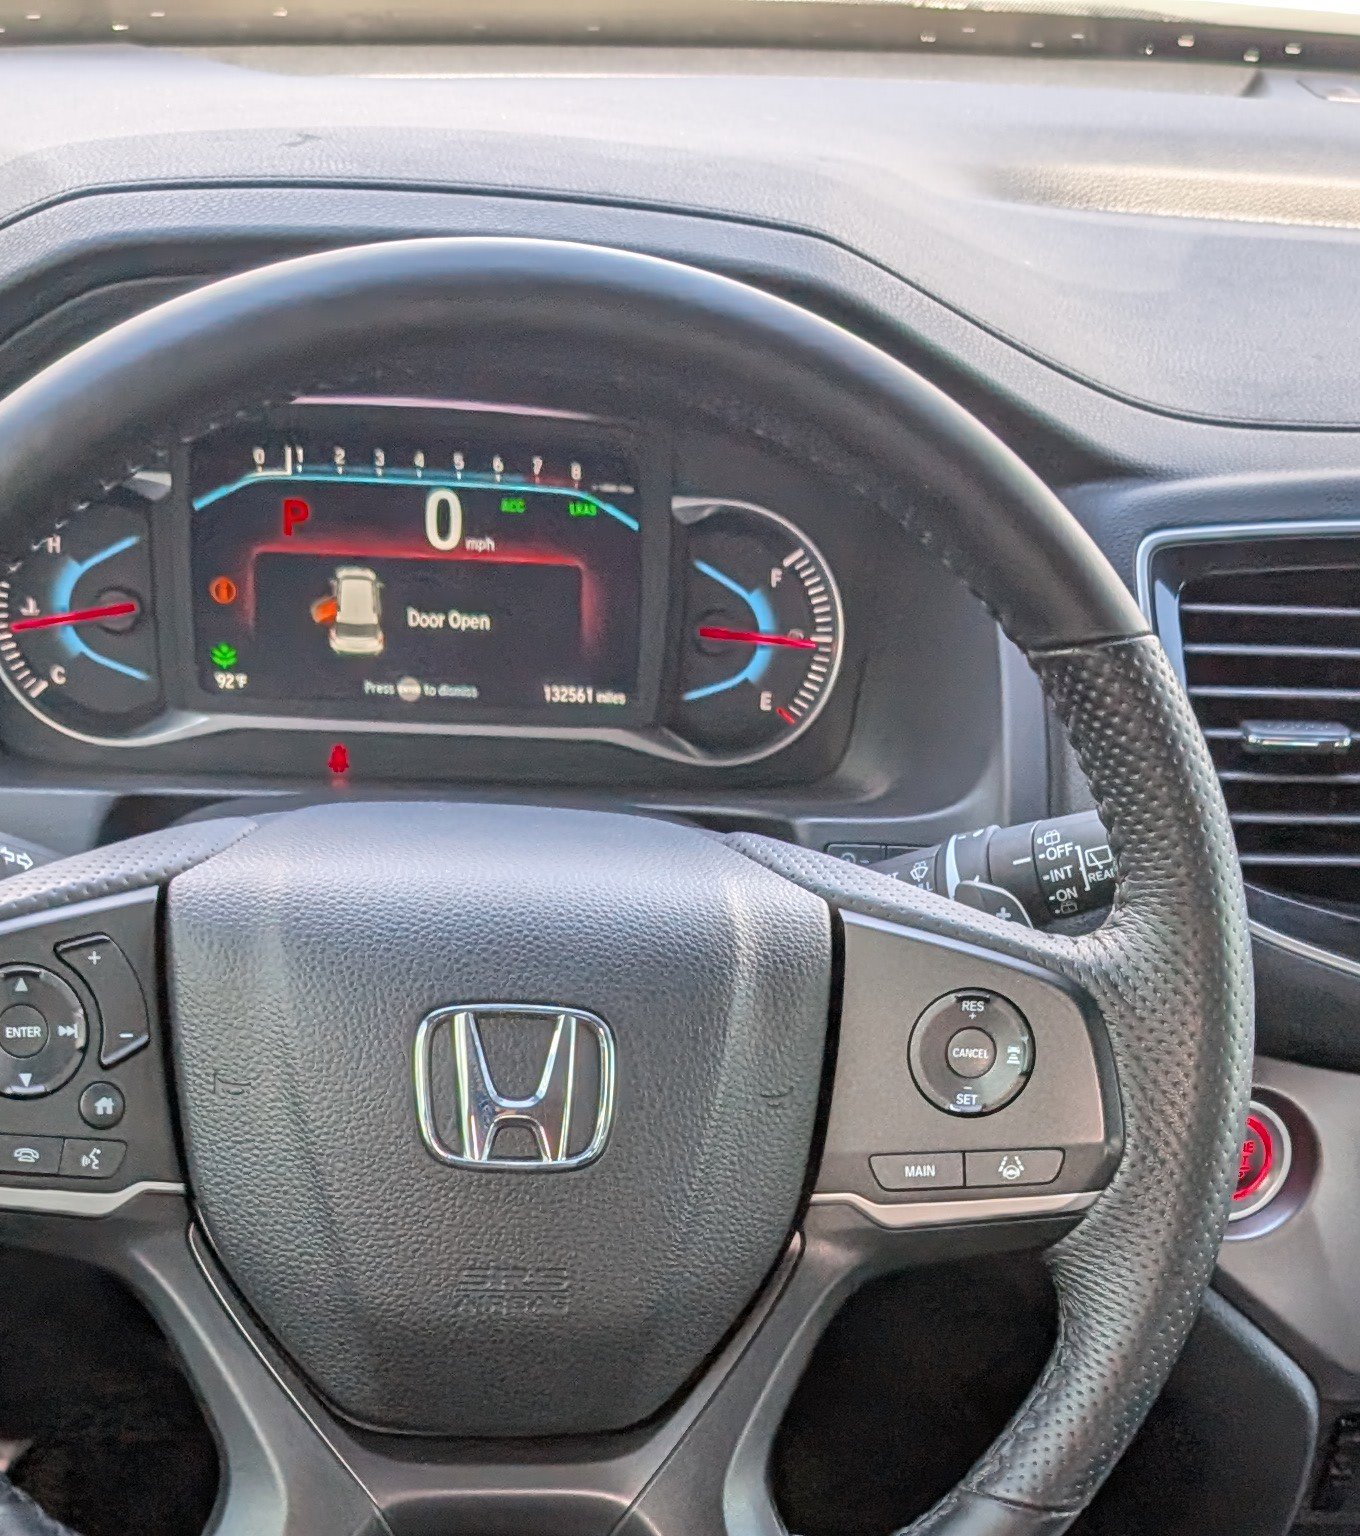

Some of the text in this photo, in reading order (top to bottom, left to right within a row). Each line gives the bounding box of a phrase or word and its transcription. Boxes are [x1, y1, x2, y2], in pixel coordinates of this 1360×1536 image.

[334, 447, 346, 465] 2
[283, 498, 309, 536] P
[425, 489, 495, 553] 0 mph
[46, 534, 62, 553] H
[770, 567, 783, 588] F
[406, 606, 492, 631] Door Open
[363, 679, 395, 695] Press
[543, 683, 594, 704] 132561
[759, 690, 773, 711] E
[1044, 842, 1074, 862] OFF
[1049, 865, 1074, 883] INT
[1055, 886, 1079, 902] ON
[961, 1000, 985, 1013] RES
[5, 1026, 42, 1038] ENTER
[952, 1047, 989, 1060] CANCEL
[955, 1093, 978, 1105] SET
[904, 1164, 937, 1178] MAIN
